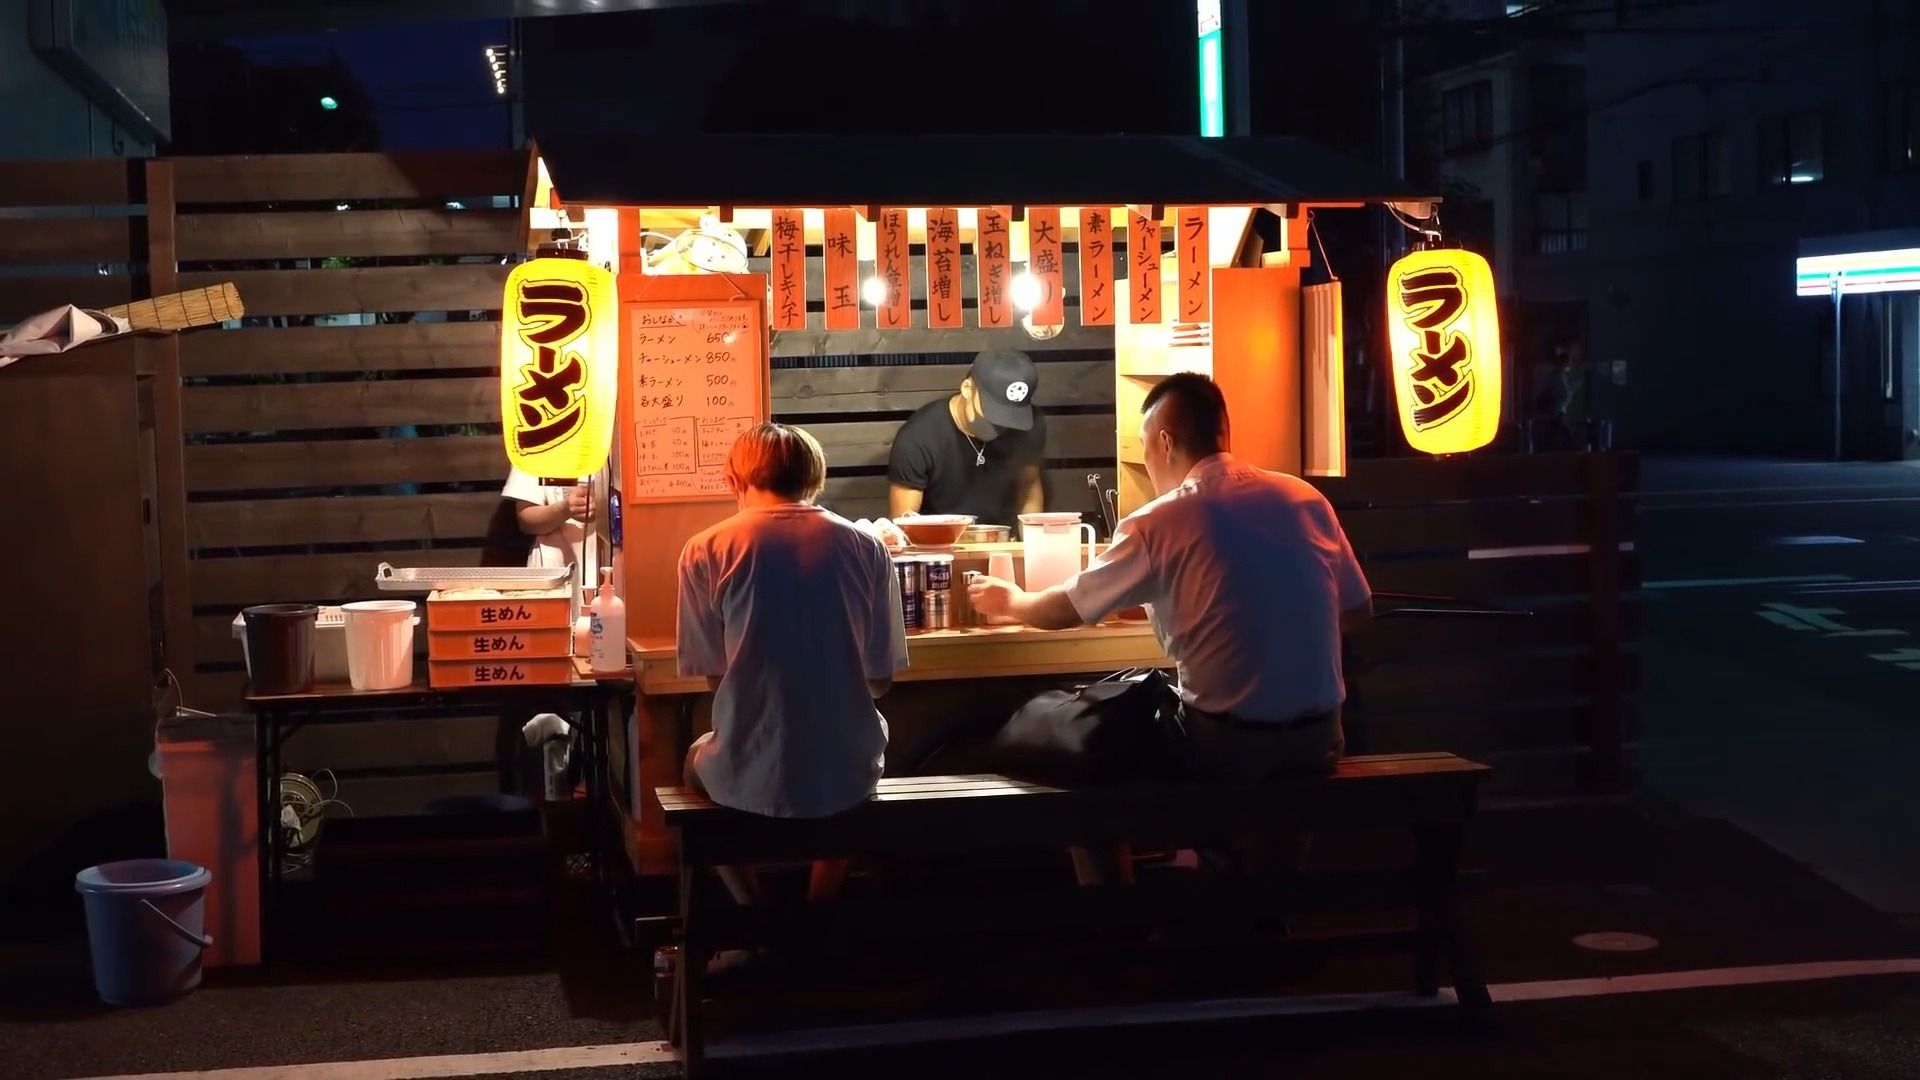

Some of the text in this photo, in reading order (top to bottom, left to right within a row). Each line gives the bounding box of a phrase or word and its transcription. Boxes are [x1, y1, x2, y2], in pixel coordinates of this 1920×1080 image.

[776, 217, 799, 327] 梅干しキムチ
[828, 233, 856, 310] 味玉
[929, 218, 954, 322] 海苔増し
[983, 214, 1006, 325] 玉ねぎ増し
[1087, 212, 1107, 322] 素ラーメン
[1136, 216, 1158, 322] チャーシューメン
[1184, 216, 1204, 316] ラーメン
[514, 280, 590, 454] ラーメン
[639, 333, 678, 345] ラーメン
[1398, 268, 1474, 431] ラーメン
[474, 636, 524, 653] 生めん
[481, 605, 531, 623] 生めん
[474, 665, 524, 682] 生めん
